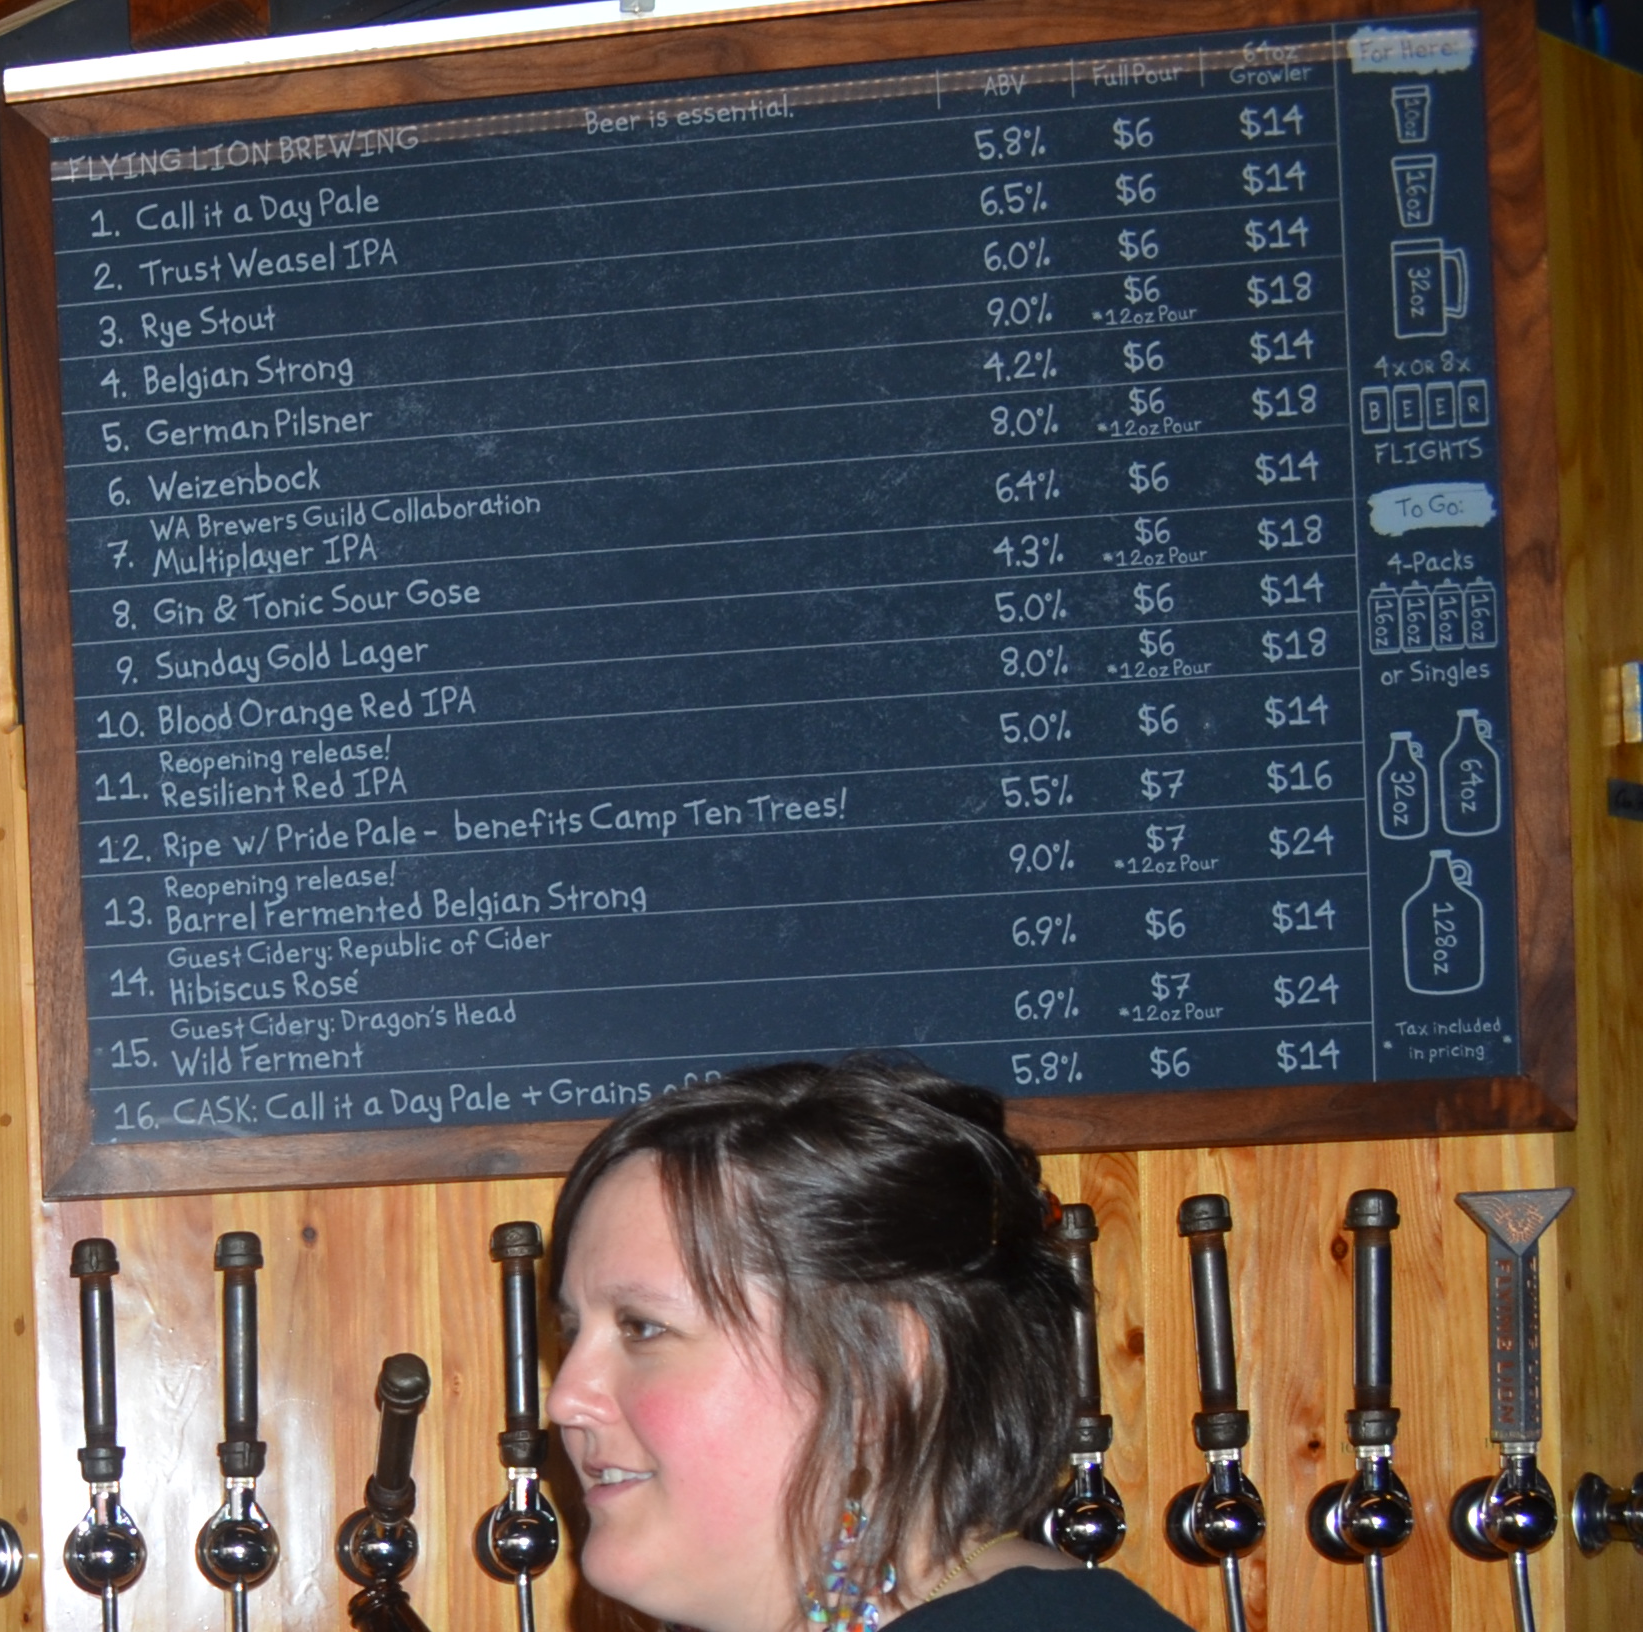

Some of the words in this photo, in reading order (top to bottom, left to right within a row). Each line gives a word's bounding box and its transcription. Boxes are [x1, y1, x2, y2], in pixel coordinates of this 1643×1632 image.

[1359, 39, 1395, 63] For
[1401, 38, 1459, 60] Here:
[984, 73, 1025, 96] ABV
[1092, 64, 1127, 86] Full
[1132, 62, 1183, 82] Pour
[1229, 65, 1312, 87] Growler
[585, 109, 640, 135] Beer
[649, 108, 669, 129] is
[676, 91, 791, 126] essential
[973, 126, 1046, 160] 5.8%
[1113, 117, 1154, 150] $6
[1239, 104, 1303, 140] $14
[69, 146, 181, 182] FLYING
[191, 140, 273, 171] LION
[279, 126, 419, 165] BREWING
[979, 181, 1048, 216] 6.5%
[1115, 172, 1156, 206] $6
[1241, 160, 1306, 195] $14
[90, 210, 120, 239] 1.
[136, 202, 194, 232] Call
[203, 199, 224, 229] it
[234, 202, 254, 224] a
[260, 194, 313, 228] Day
[319, 188, 380, 216] Pale
[94, 264, 123, 292] 2.
[139, 254, 221, 288] Trust
[227, 244, 335, 279] Weasel
[343, 239, 399, 269] IPA
[986, 292, 1052, 327] 9.0%
[1123, 274, 1160, 304] $6
[1246, 271, 1312, 308] $18
[1408, 266, 1430, 318] 32oz
[99, 318, 124, 348] 3.
[140, 314, 191, 348] Rye
[200, 305, 276, 336] Stout
[101, 369, 127, 399] 4.
[143, 364, 249, 400] Belgian
[256, 356, 355, 388] Strong
[103, 422, 130, 452] 5.
[145, 418, 269, 448] German
[274, 408, 374, 439] Pilsner
[1375, 439, 1483, 465] FLIGHTS
[107, 478, 131, 506] 6.
[147, 461, 323, 502] Weizenbock
[150, 516, 191, 541] WA
[197, 510, 297, 536] Brewers
[304, 500, 366, 529] Guild
[370, 491, 541, 524] Collaboration
[1397, 500, 1423, 518] To
[1429, 496, 1465, 515] Go:
[109, 540, 135, 569] 7.
[153, 540, 314, 582] Multiplayer
[323, 535, 377, 564] IPA
[1386, 552, 1475, 574] 4-Packs
[1381, 666, 1404, 684] or
[1410, 661, 1491, 687] Singles
[98, 836, 152, 865] 12.
[162, 831, 222, 868] Ripe
[232, 827, 269, 855] w/
[276, 823, 350, 854] Pride
[356, 816, 418, 847] Pale
[454, 803, 584, 843] benefits
[588, 800, 678, 838] Camp
[683, 798, 743, 827] Ten
[748, 788, 849, 822] Trees!
[1432, 901, 1457, 976] 128oz
[1396, 1022, 1428, 1036] Tax
[1432, 1018, 1503, 1034] included
[1409, 1045, 1426, 1058] in
[1428, 1042, 1486, 1061] pricing
